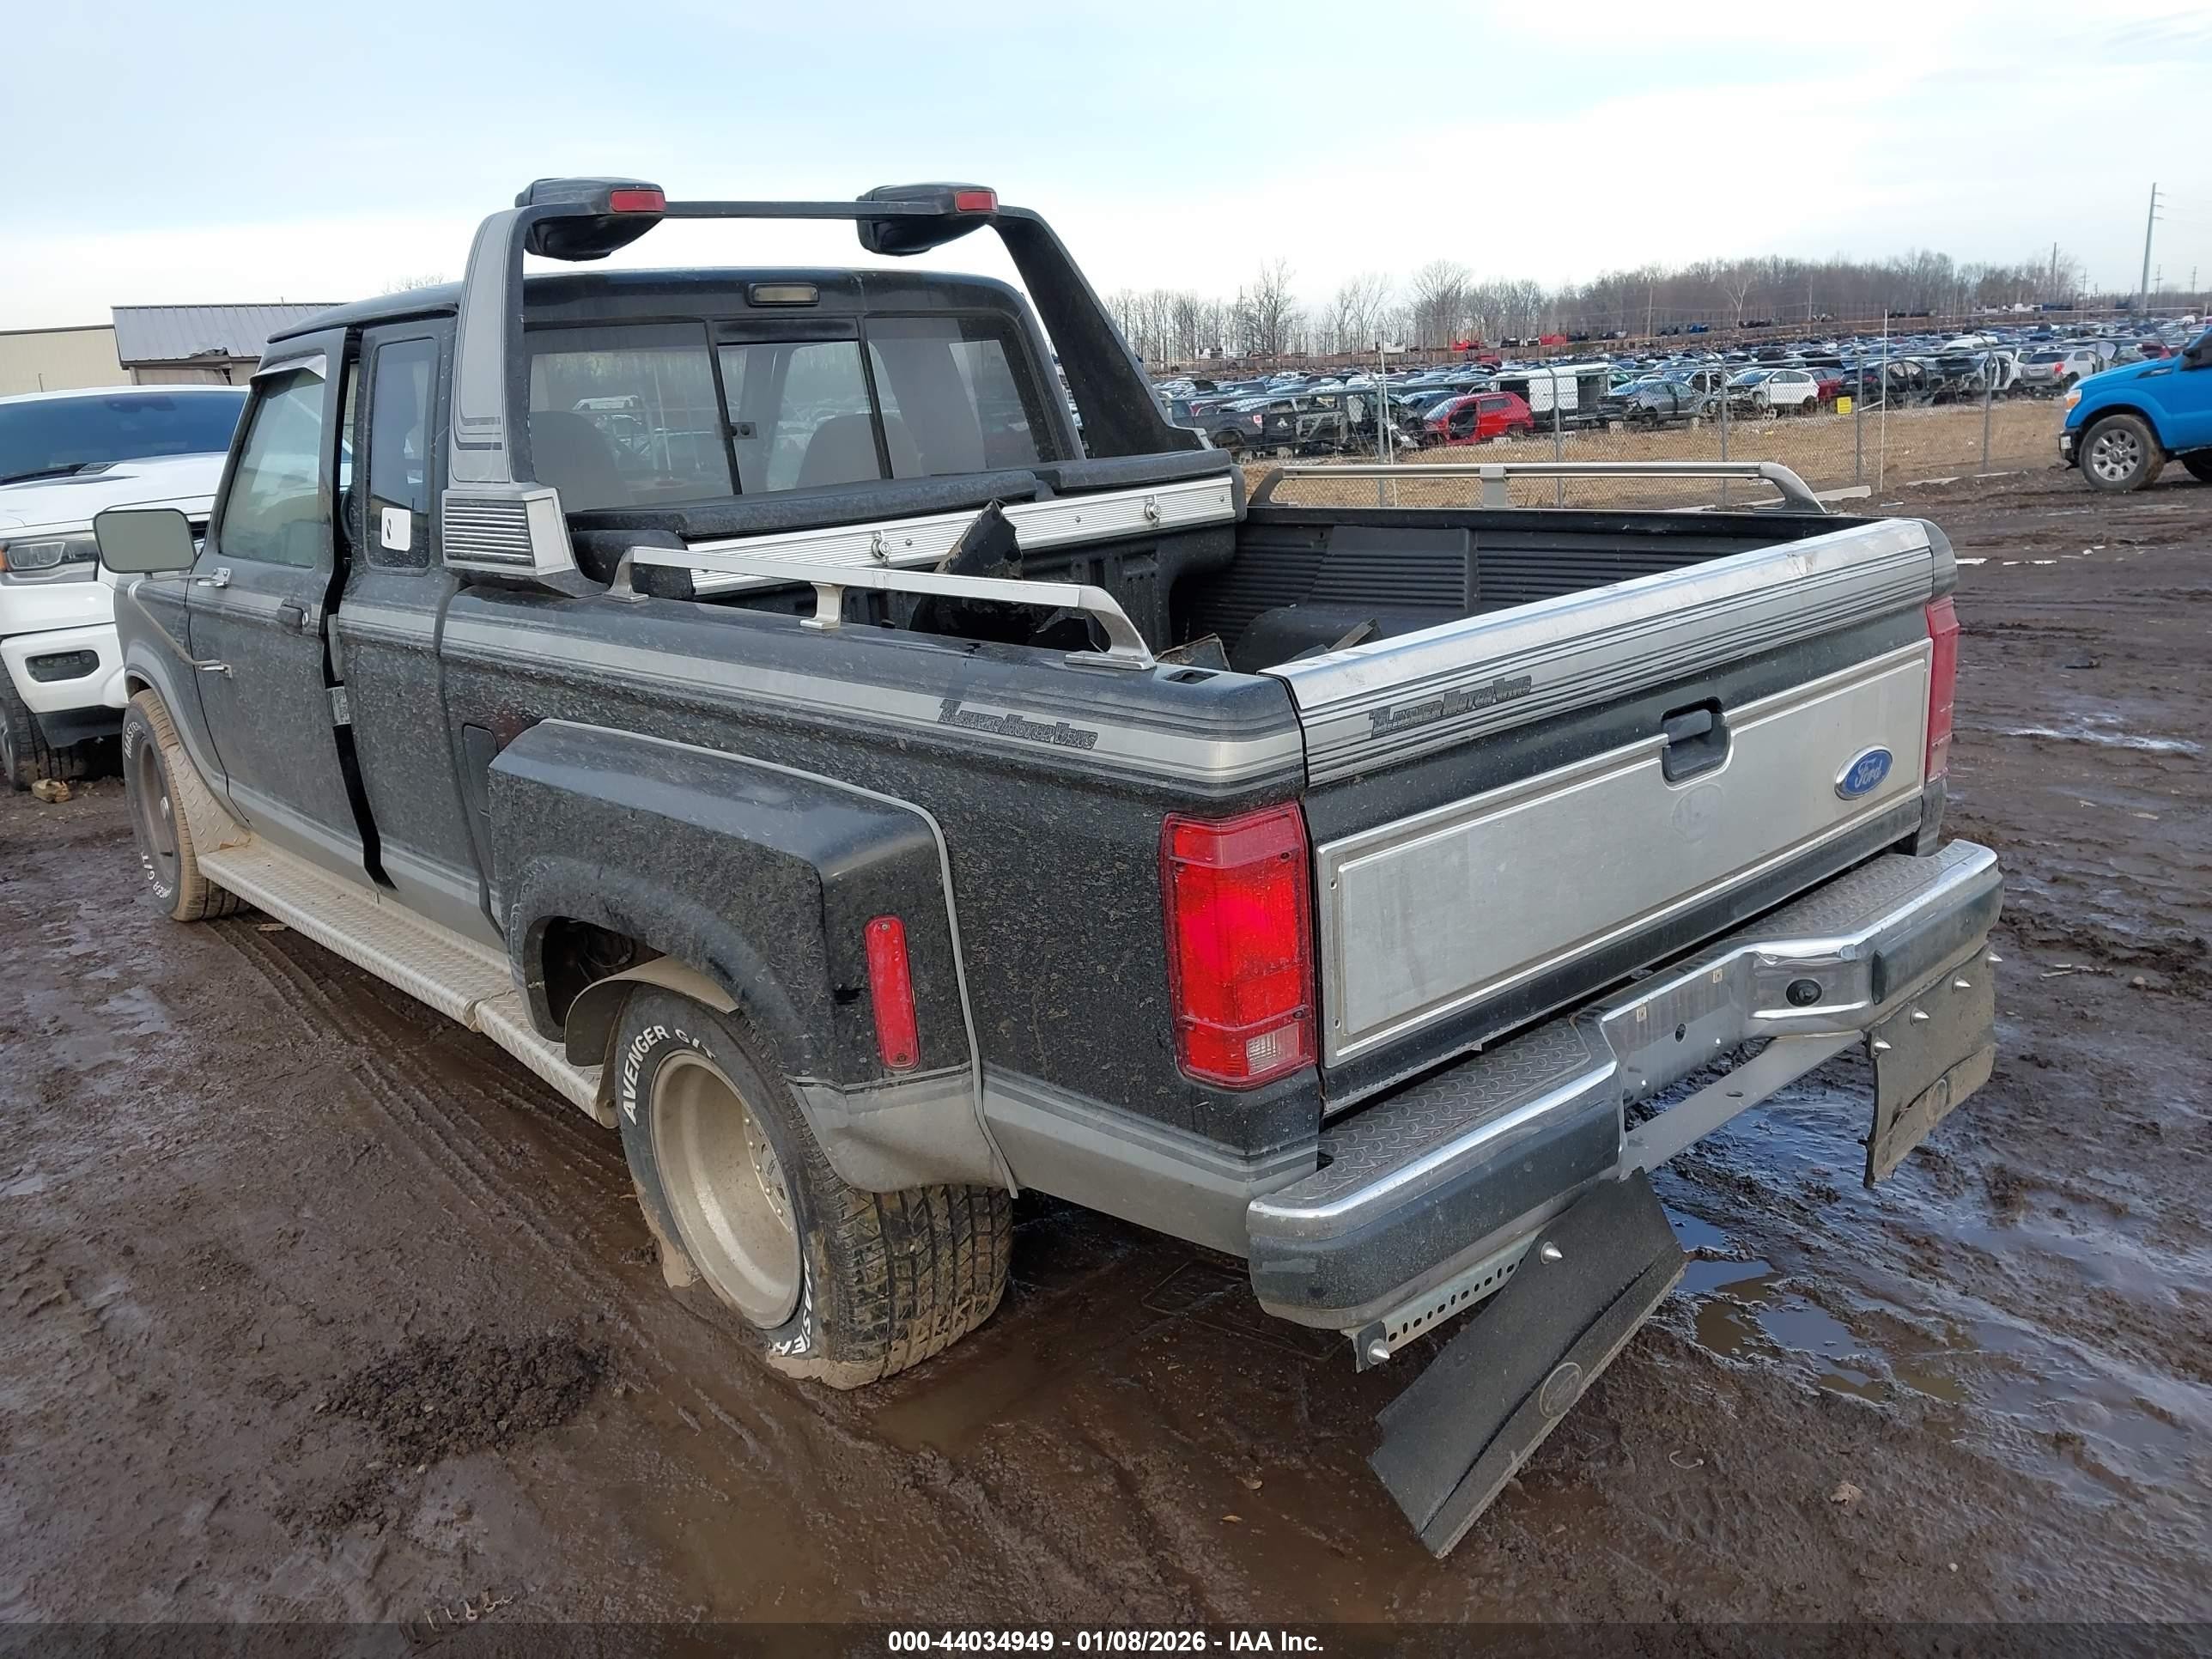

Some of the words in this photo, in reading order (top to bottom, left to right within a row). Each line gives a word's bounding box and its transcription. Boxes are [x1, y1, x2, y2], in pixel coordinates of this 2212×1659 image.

[1854, 757, 1883, 788] Ford
[623, 1025, 672, 1127] AVENGER
[763, 1249, 812, 1356] MASTER
